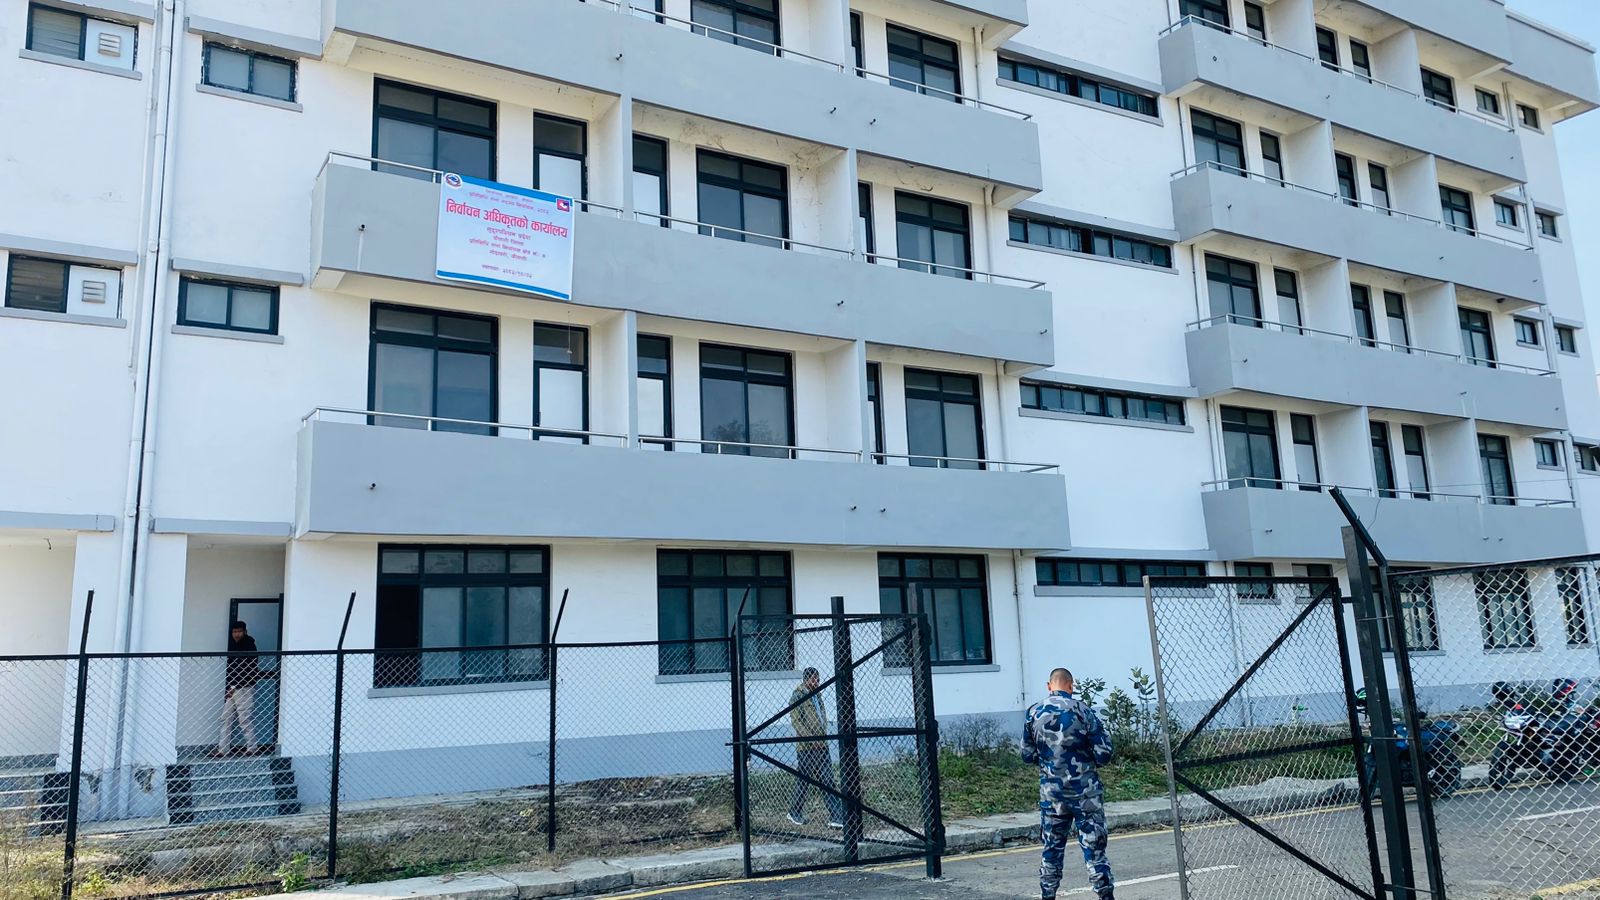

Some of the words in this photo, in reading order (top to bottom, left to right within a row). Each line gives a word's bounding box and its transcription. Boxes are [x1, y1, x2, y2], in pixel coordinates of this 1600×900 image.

[446, 198, 480, 218] निर्वाचन
[483, 209, 528, 228] अधिकृतको
[531, 221, 568, 238] कार्यालय
